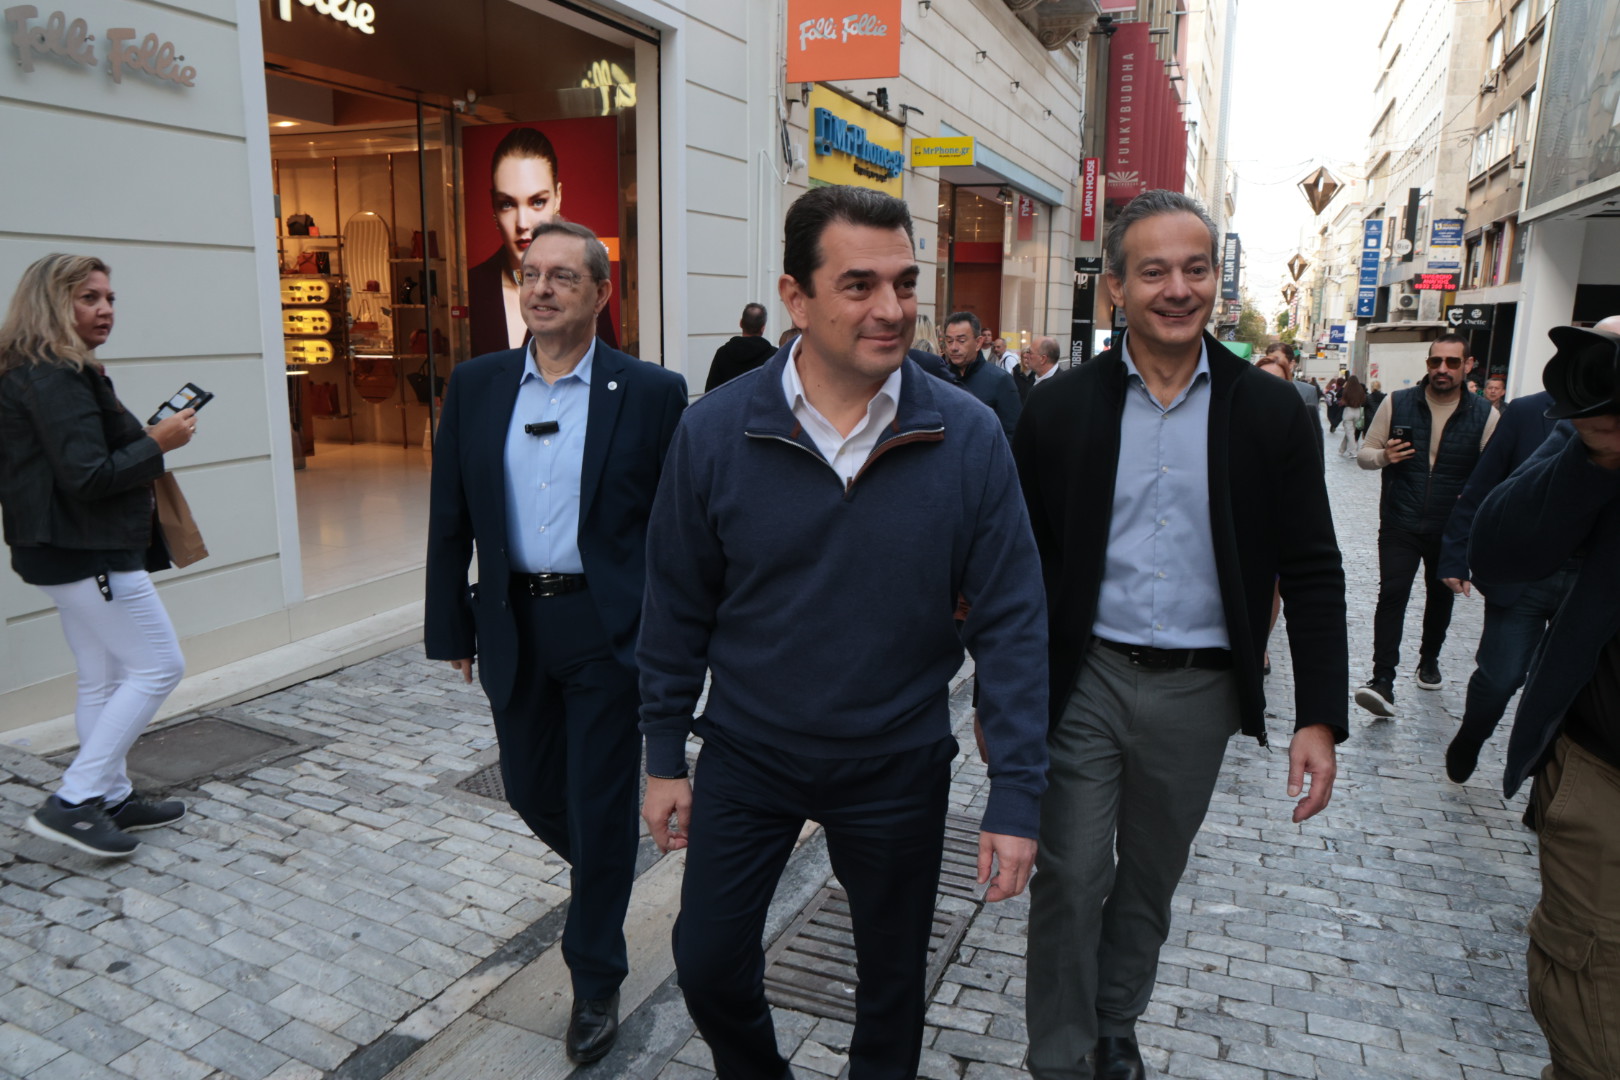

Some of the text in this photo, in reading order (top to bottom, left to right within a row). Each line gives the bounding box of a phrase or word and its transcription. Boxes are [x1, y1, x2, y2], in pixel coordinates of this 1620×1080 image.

[4, 5, 197, 88] Folli Follie
[799, 13, 888, 51] Folli Follie
[1118, 53, 1134, 164] FUNKYBUDDHA
[832, 115, 905, 178] MrPhone.gr
[923, 146, 971, 156] MrPhone.gr
[1085, 159, 1096, 217] LAPIN HOUSE
[1223, 261, 1235, 282] SLAM
[1225, 238, 1237, 261] DUNK
